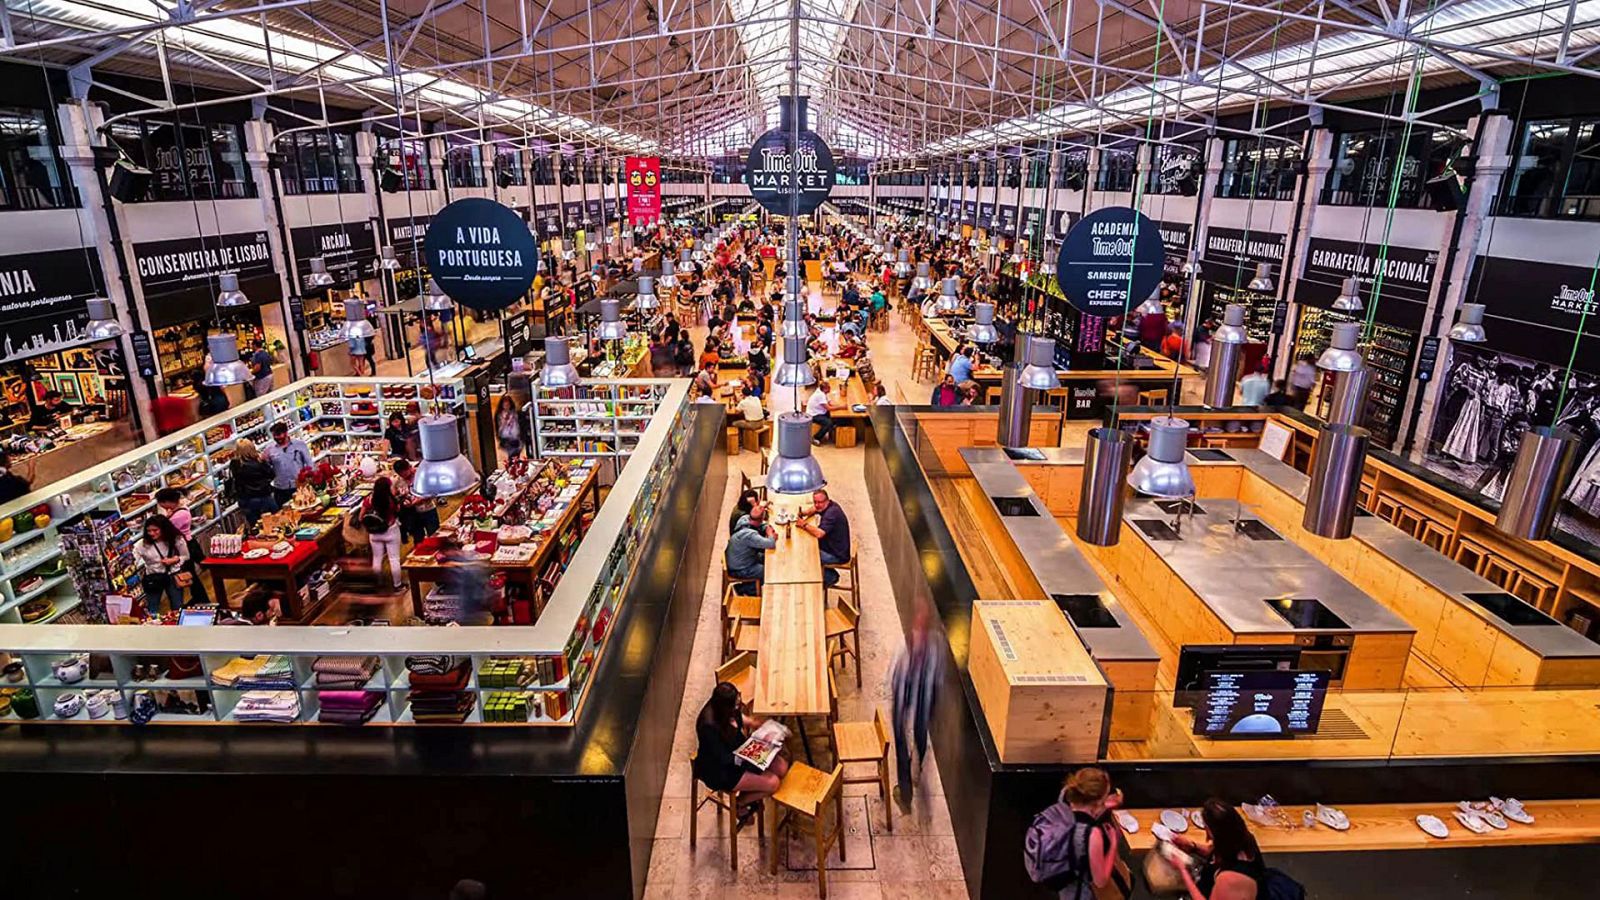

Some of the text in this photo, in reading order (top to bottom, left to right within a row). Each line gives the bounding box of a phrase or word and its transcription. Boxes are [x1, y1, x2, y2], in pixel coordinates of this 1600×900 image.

[761, 148, 818, 173] Time Out
[753, 174, 828, 186] MARKET
[394, 224, 426, 240] MANTEIARIA
[456, 227, 501, 244] A VIDA
[1091, 222, 1139, 236] ACADEMIA
[1092, 237, 1134, 256] Time Out
[1208, 236, 1284, 260] GARRAFEIRA NACIONAL
[139, 248, 219, 277] CONSERVEIRA
[220, 246, 235, 265] DE
[234, 243, 270, 263] LISBOA
[438, 249, 523, 267] PORTUGUESA
[1312, 249, 1370, 274] GARRAFEIRA
[1372, 257, 1430, 283] NACIONAL
[0, 269, 36, 297] NJA
[1087, 271, 1132, 280] SAMSUNG
[1087, 290, 1127, 299] CHEF'S
[2, 302, 30, 312] autores
[1075, 399, 1092, 409] BAR
